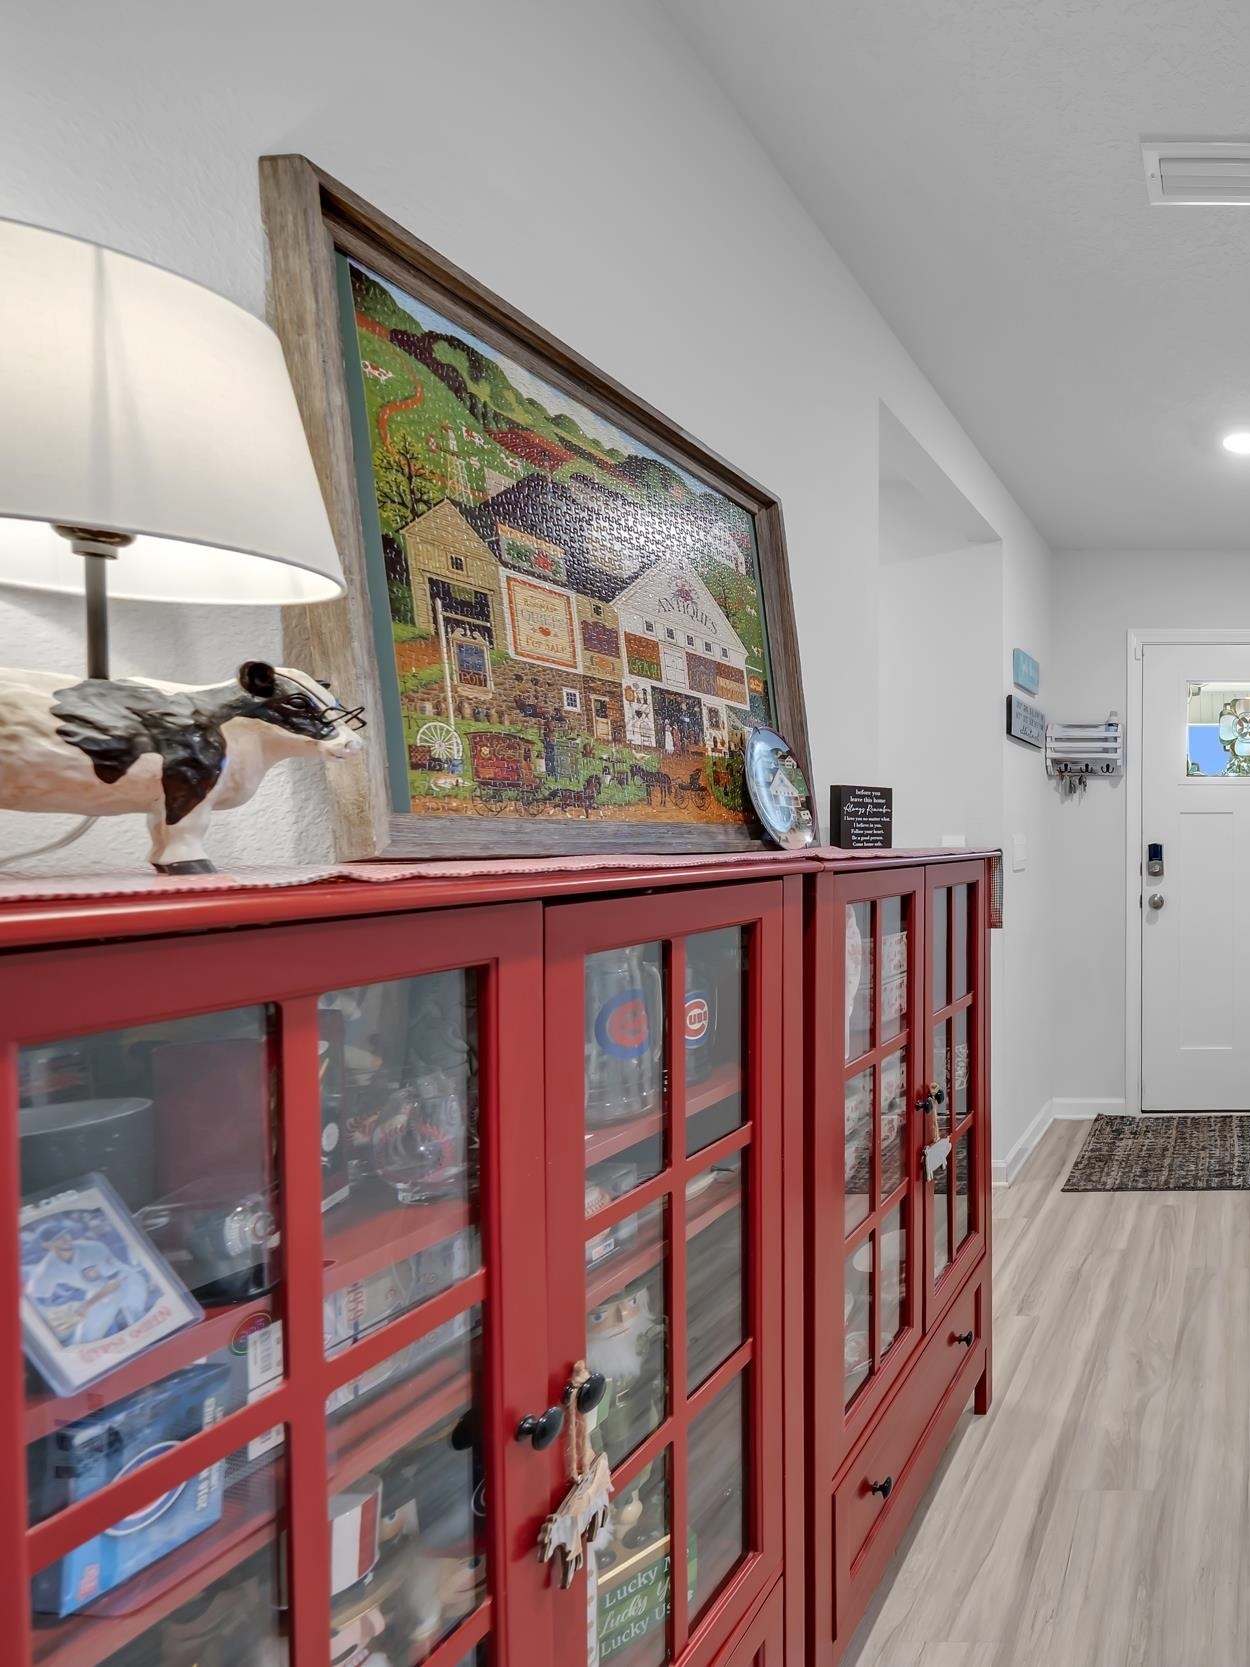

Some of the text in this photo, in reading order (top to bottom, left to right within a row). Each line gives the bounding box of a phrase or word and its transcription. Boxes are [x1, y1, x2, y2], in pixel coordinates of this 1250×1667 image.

[658, 597, 718, 634] ANTIQUES
[844, 803, 865, 815] Always
[604, 1566, 658, 1609] Lucky
[600, 1617, 649, 1656] Lucky
